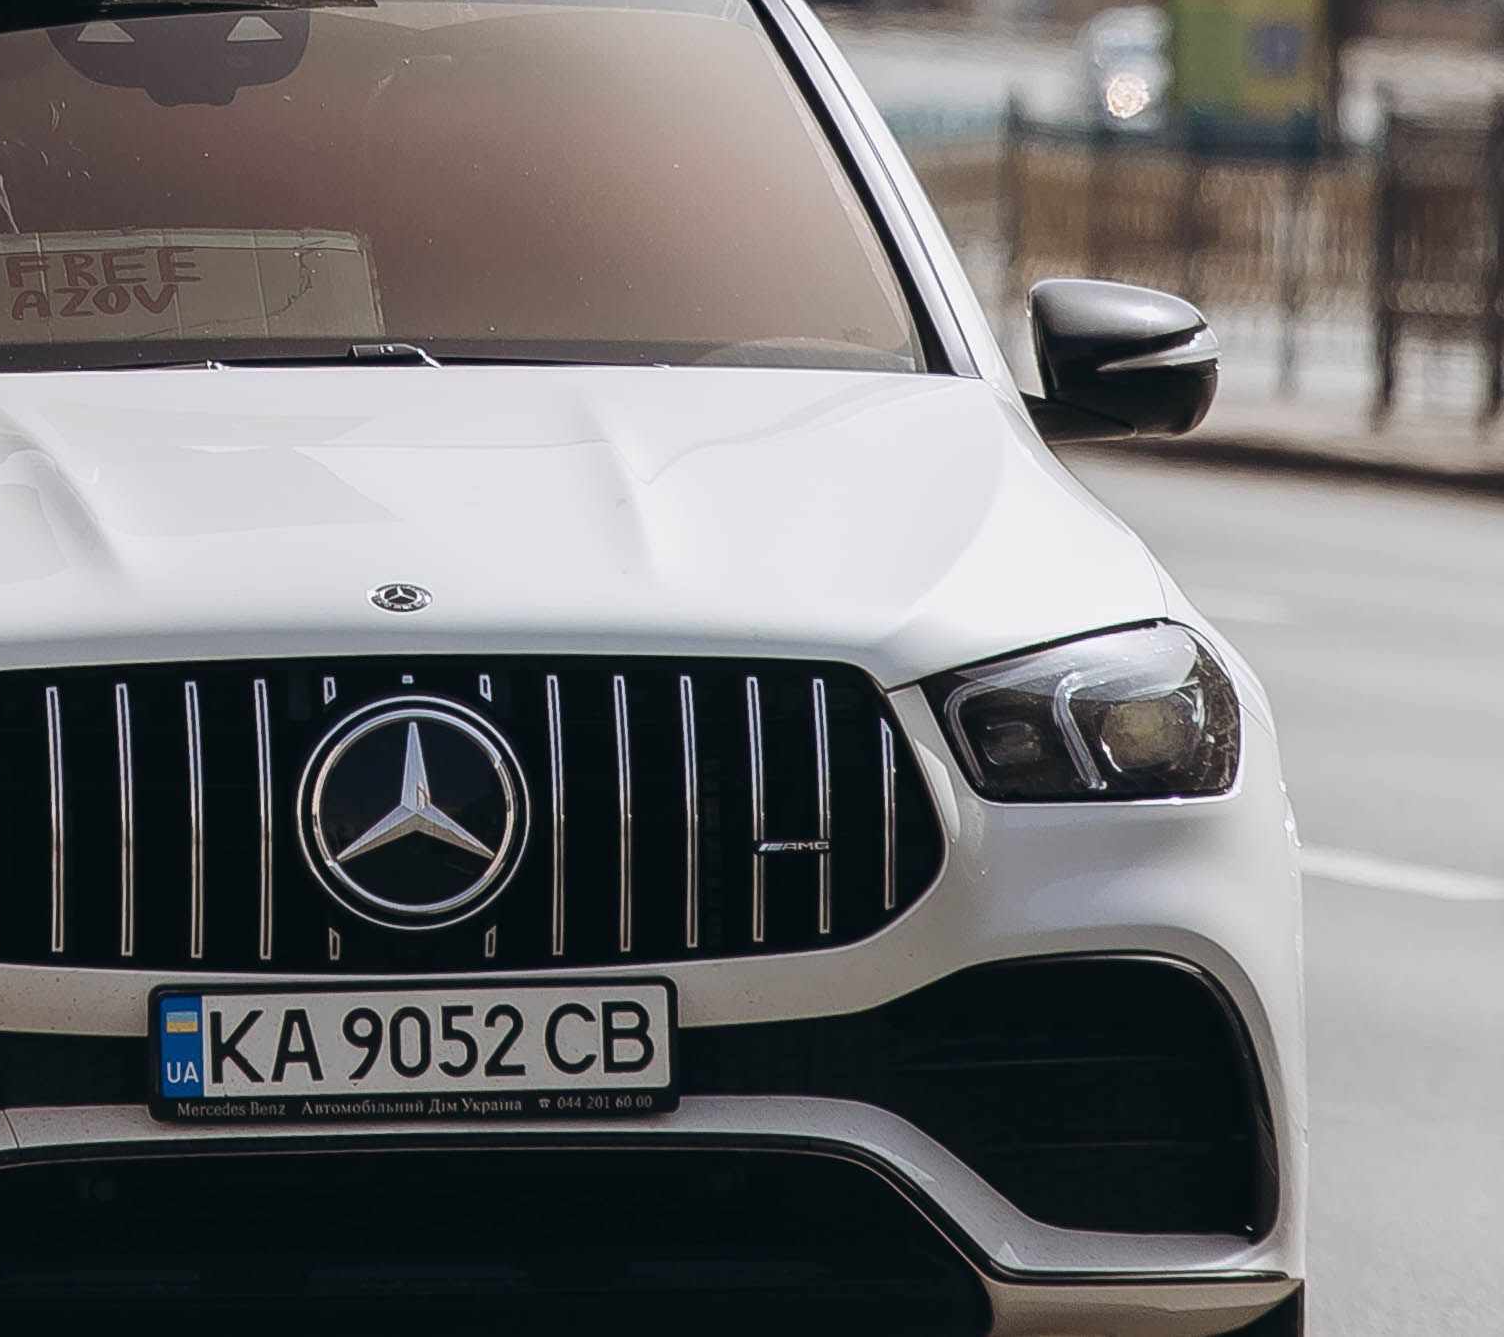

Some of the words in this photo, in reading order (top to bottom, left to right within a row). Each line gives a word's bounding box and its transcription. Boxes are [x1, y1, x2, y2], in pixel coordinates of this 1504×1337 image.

[6, 247, 202, 288] FREE
[11, 284, 179, 321] AZOV
[782, 841, 830, 851] AMG
[208, 1007, 325, 1085] KA
[342, 1004, 526, 1081] 9052
[545, 1000, 655, 1075] CB
[166, 1061, 200, 1084] UA
[301, 1098, 424, 1116] Автомобільний
[428, 1097, 458, 1115] Дім
[461, 1097, 523, 1115] Україна
[557, 1095, 582, 1110] 044
[587, 1095, 611, 1110] 201
